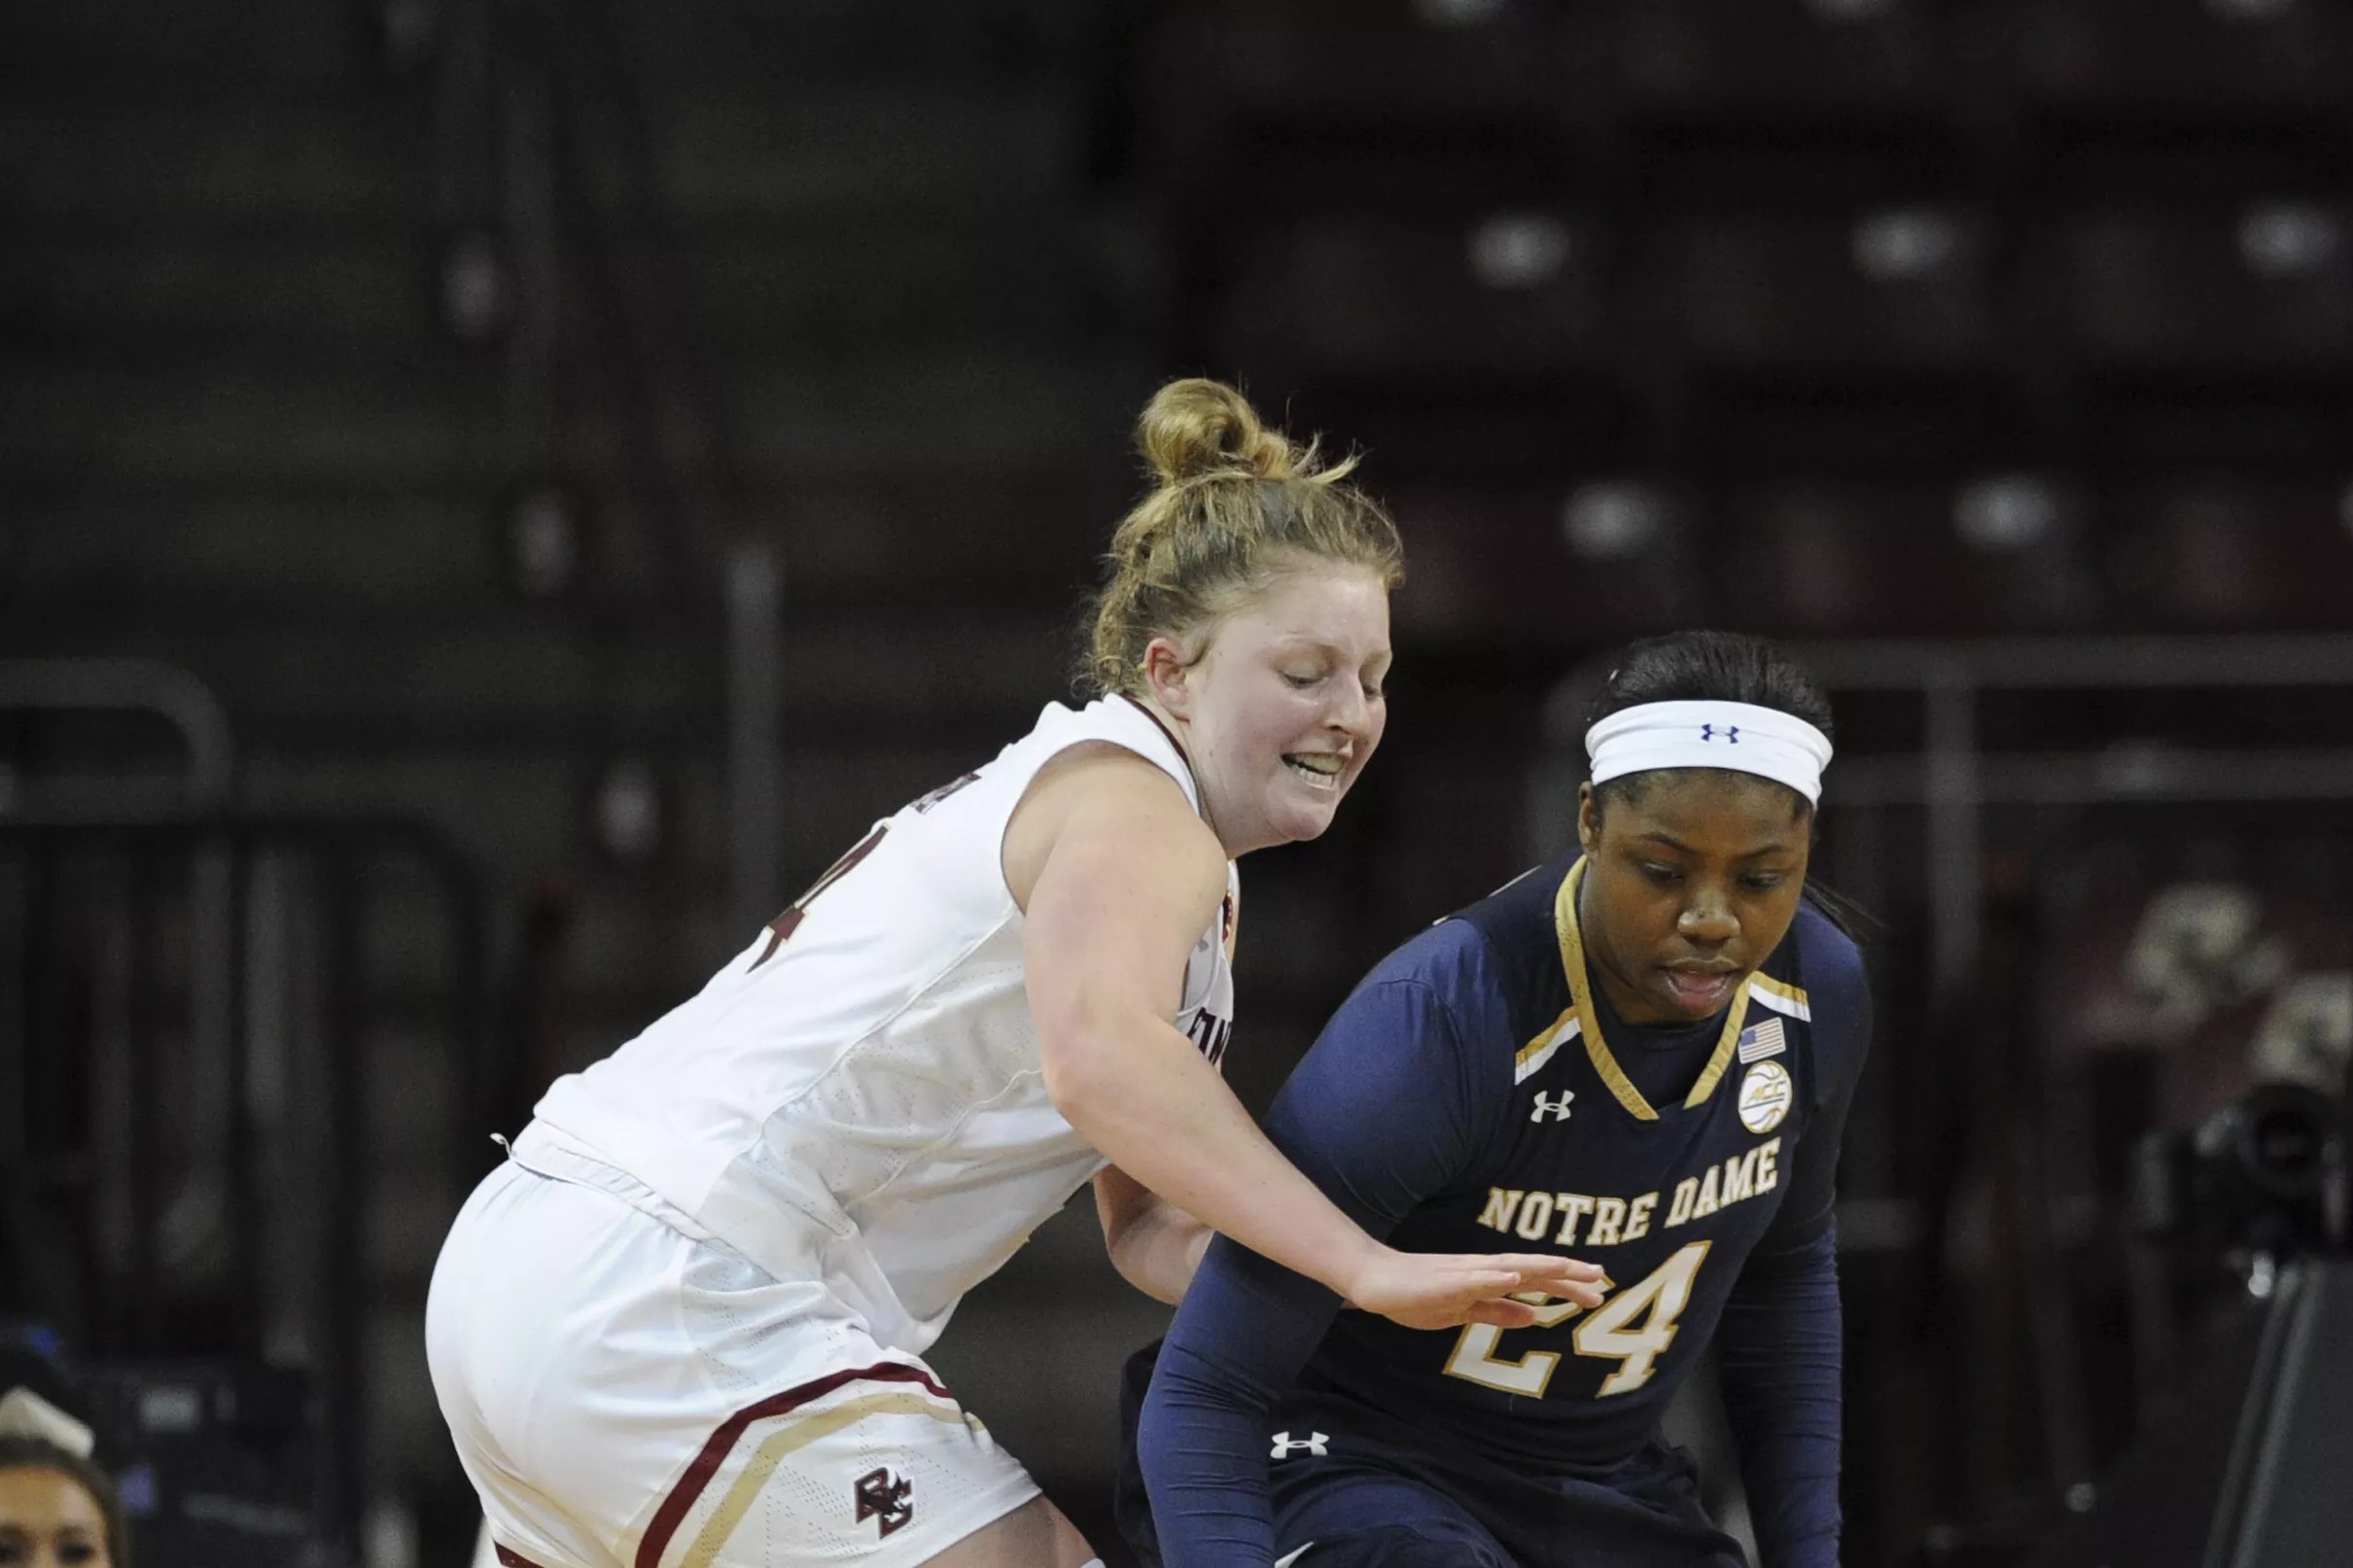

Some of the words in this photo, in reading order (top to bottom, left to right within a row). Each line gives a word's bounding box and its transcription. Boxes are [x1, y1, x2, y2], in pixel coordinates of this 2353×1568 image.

[1476, 1186, 1659, 1246] NOTRE
[1664, 1136, 1781, 1230] DAME
[1442, 1239, 1713, 1400] 24
